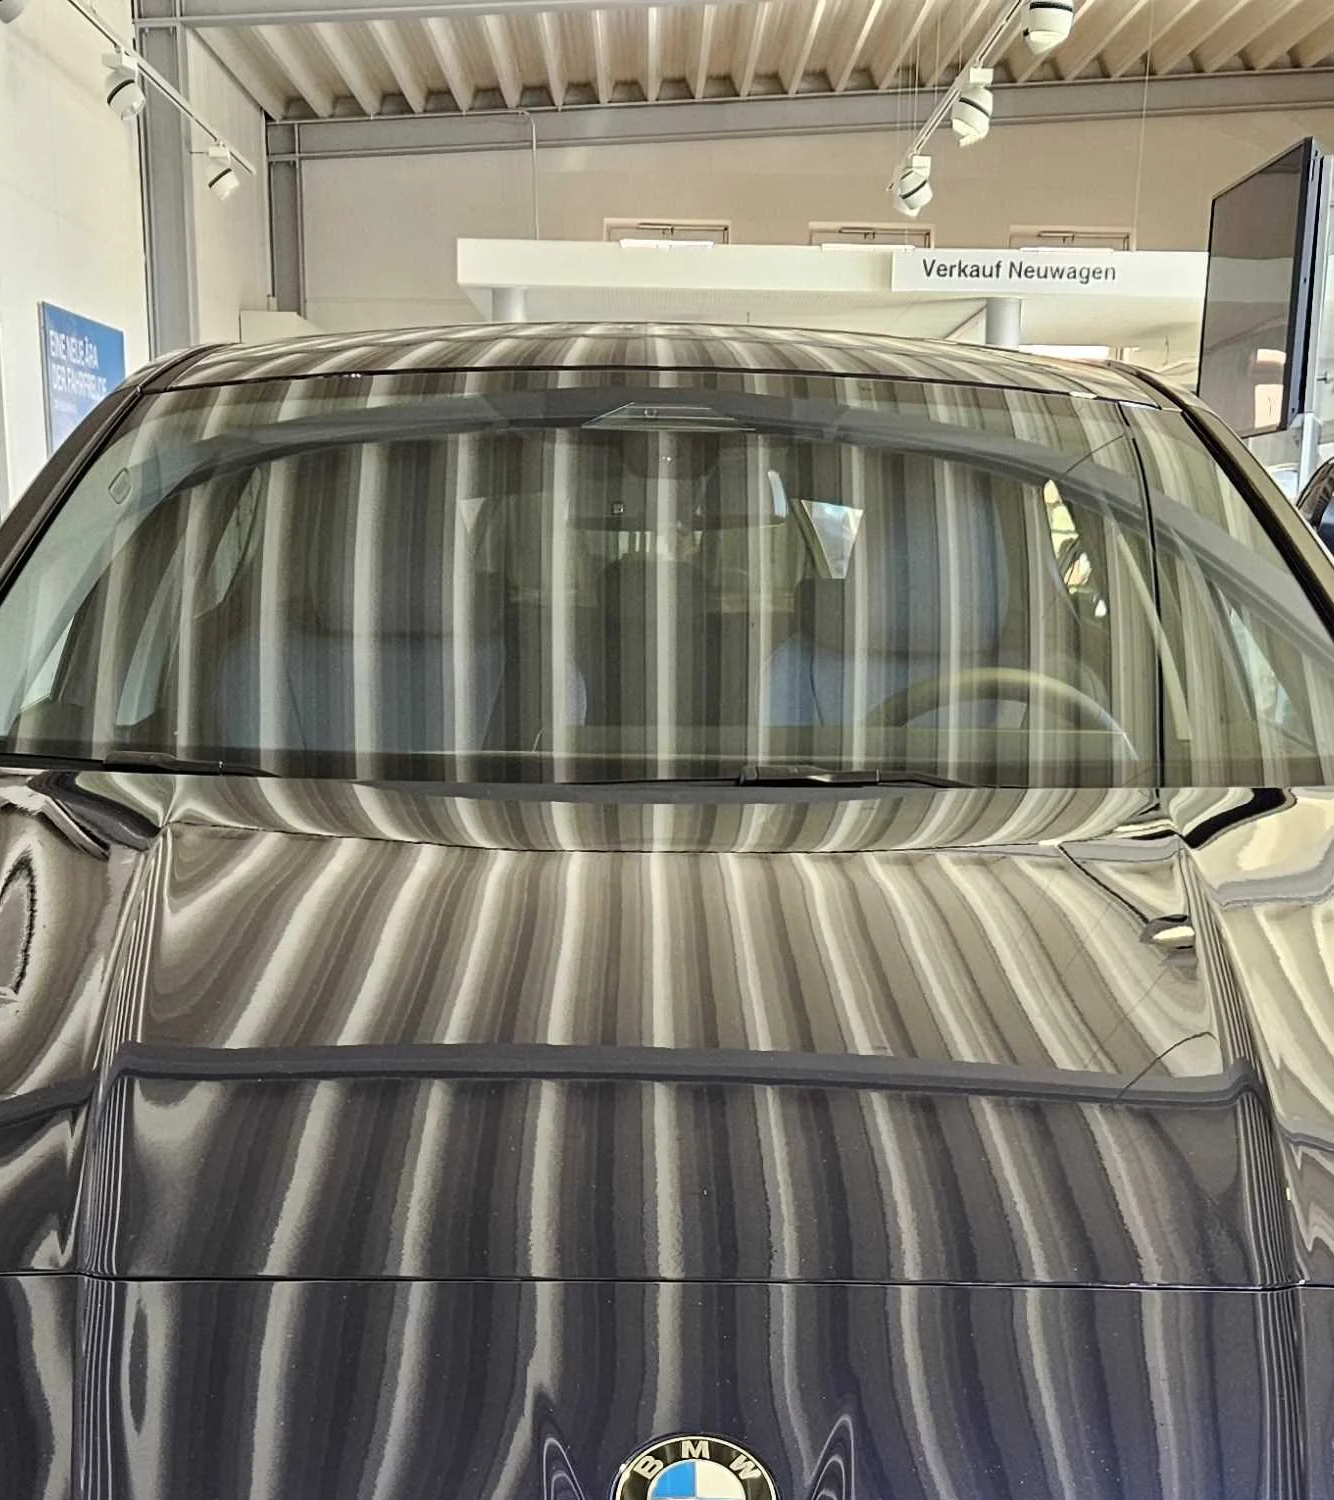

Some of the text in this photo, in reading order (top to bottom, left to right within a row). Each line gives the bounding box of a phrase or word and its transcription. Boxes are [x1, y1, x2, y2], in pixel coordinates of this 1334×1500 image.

[922, 258, 1117, 285] Verkauf Neuwagen
[632, 1439, 763, 1481] BMW
